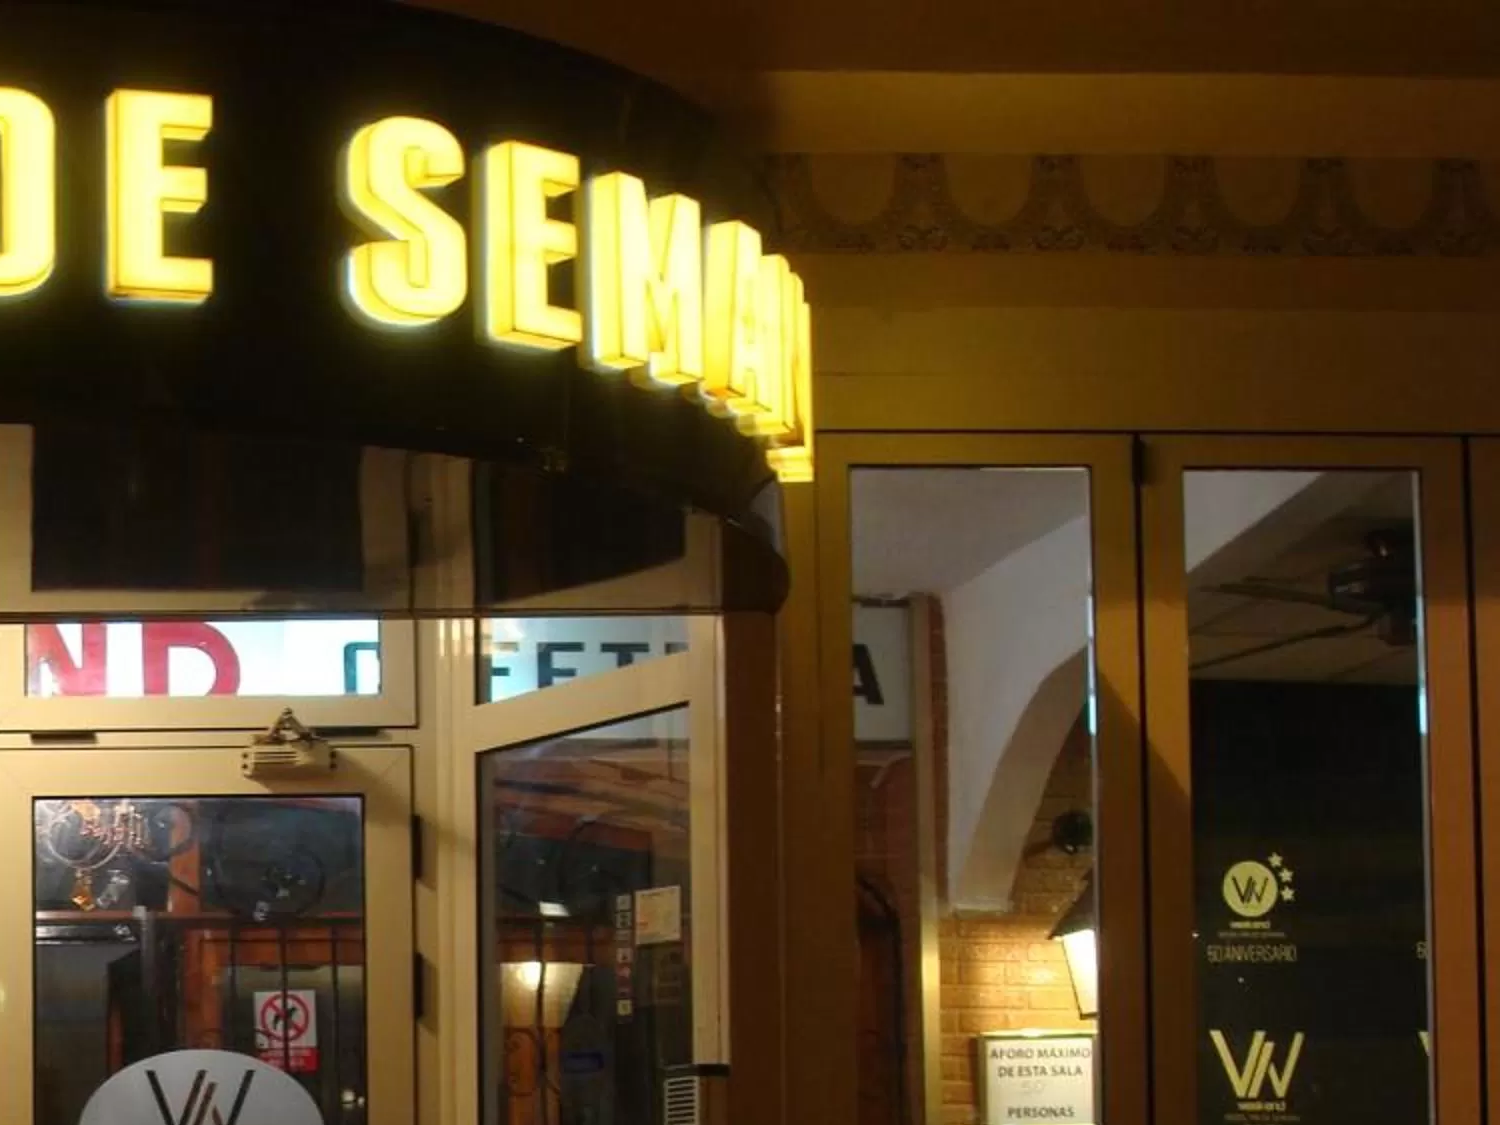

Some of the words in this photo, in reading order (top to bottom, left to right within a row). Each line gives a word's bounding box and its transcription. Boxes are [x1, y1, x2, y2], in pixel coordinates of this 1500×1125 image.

[990, 1047, 1035, 1060] AFORO
[997, 1065, 1015, 1078] DE
[1017, 1065, 1048, 1077] ESTA
[1051, 1065, 1083, 1077] SALA
[1007, 1106, 1076, 1119] PERSONAS
